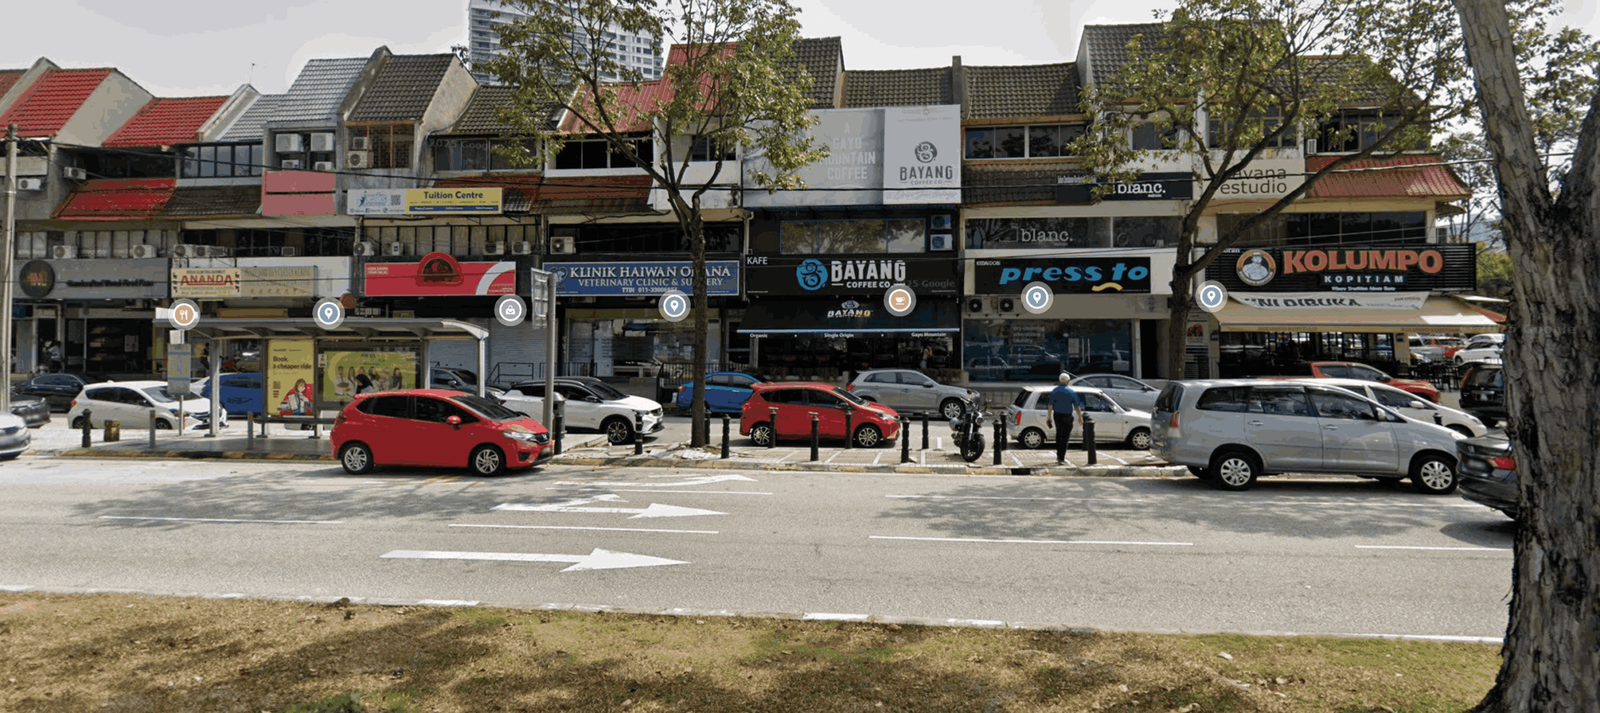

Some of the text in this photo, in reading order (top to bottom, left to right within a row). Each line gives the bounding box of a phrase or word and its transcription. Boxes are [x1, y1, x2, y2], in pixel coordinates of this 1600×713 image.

[833, 137, 862, 150] GAYO
[827, 167, 867, 180] COFFEE
[900, 165, 953, 181] BAYANG
[1220, 180, 1287, 194] estudio
[424, 191, 483, 199] Tuition Centre
[1020, 228, 1073, 242] blanc.
[747, 256, 768, 265] KAFE
[1283, 249, 1443, 275] KOLUMPO
[570, 267, 615, 278] KLINIK
[620, 266, 677, 278] HAIWAN
[831, 260, 906, 282] BAYANG
[999, 262, 1148, 285] press to
[180, 274, 234, 286] ANANDA
[578, 278, 724, 287] VETERINARY CLINIC & SUERY
[1324, 275, 1404, 283] KOPITIAM
